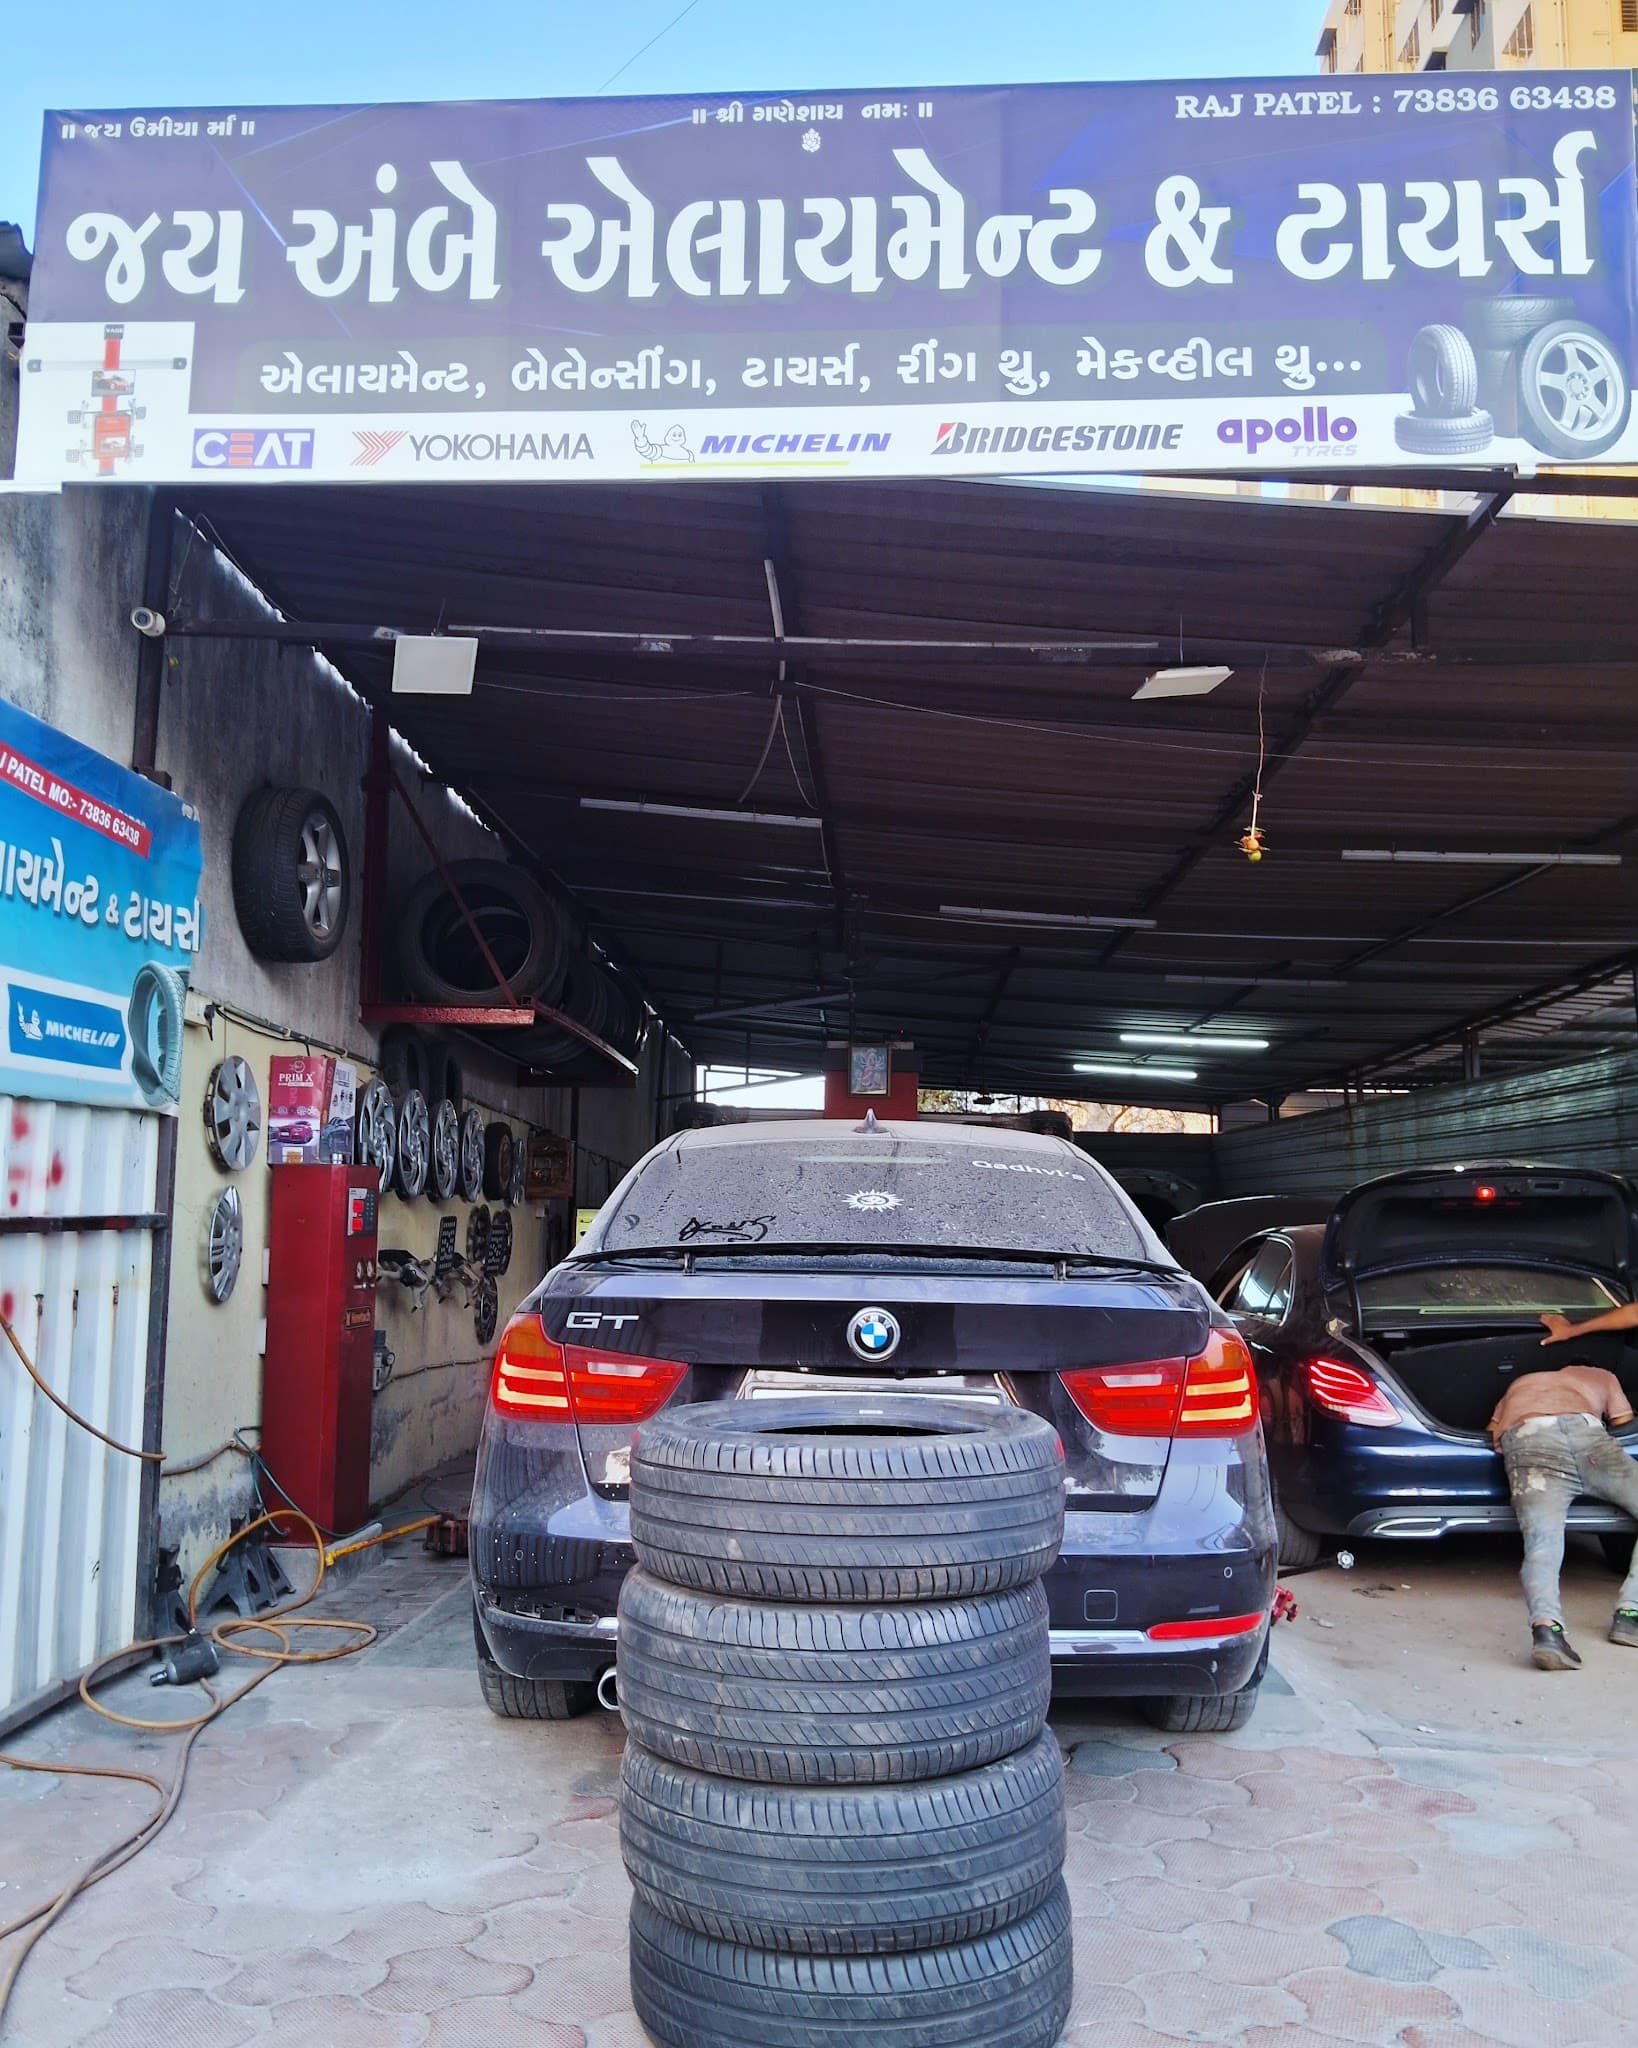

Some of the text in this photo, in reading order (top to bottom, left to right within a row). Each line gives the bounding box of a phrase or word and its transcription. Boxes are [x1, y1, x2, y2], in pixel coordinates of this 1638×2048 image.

[715, 100, 744, 123] શ્રી
[752, 99, 844, 123] ગણેશાય
[1175, 93, 1244, 119] RAJ
[1253, 91, 1362, 116] PATEL
[1393, 87, 1499, 113] 73836
[1510, 85, 1617, 110] 63438
[84, 123, 122, 139] જય
[129, 116, 199, 137] ઉમીયા
[66, 130, 1598, 305] જય અંબે એલાયમેન્ટ & ટાયર્સ
[260, 350, 487, 400] એલાયમેન્ટ,
[511, 345, 718, 397] બેલેન્સીંગ,
[741, 342, 872, 393] ટાયર્સ,
[896, 338, 976, 384] રીંગ
[998, 349, 1052, 397] થ્રુ,
[1076, 336, 1254, 381] મેકવ્હીલ
[699, 432, 893, 455] MICHELIN
[930, 422, 1184, 455] BRIDGESTONE
[1216, 406, 1358, 455] apollo
[195, 431, 311, 466] CEAT
[408, 432, 595, 462] YOKOHAMA
[1292, 444, 1358, 457] TYRES
[7, 758, 46, 795] PATEL
[80, 799, 111, 829] 73836
[112, 819, 141, 847] 63438
[105, 893, 120, 925] &
[45, 1019, 121, 1049] MICHELIN
[566, 1311, 641, 1330] GT
